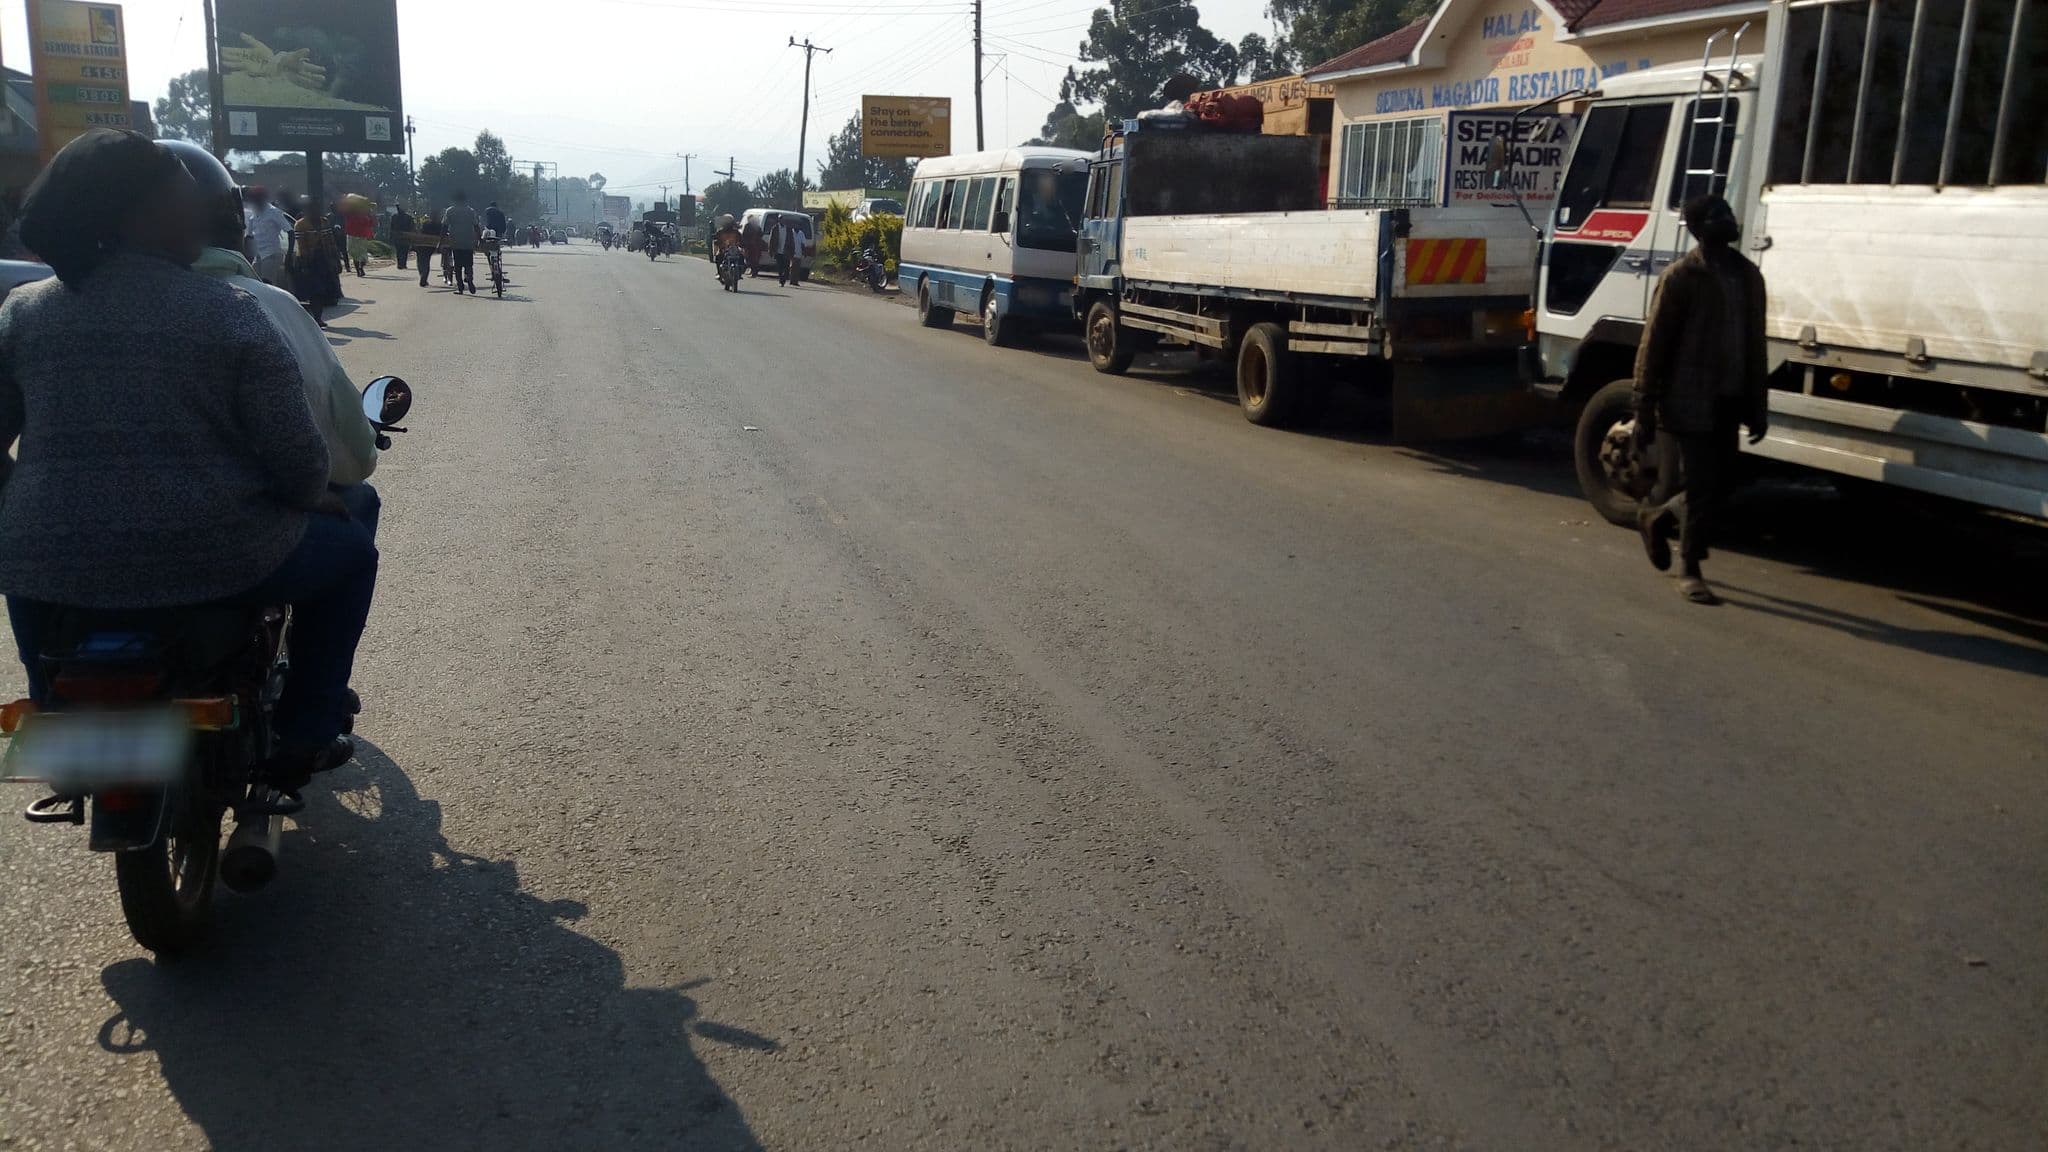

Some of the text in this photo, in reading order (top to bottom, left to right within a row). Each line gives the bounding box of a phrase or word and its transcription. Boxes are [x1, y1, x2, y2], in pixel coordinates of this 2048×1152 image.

[1481, 8, 1541, 39] HALAL
[1431, 76, 1499, 109] MAGADIR
[870, 107, 911, 119] Stay on
[870, 118, 923, 129] the better
[870, 127, 933, 138] connection.
[1460, 145, 1561, 166] MAADIR
[1454, 170, 1539, 191] RESTRANT
[1456, 192, 1473, 201] For
